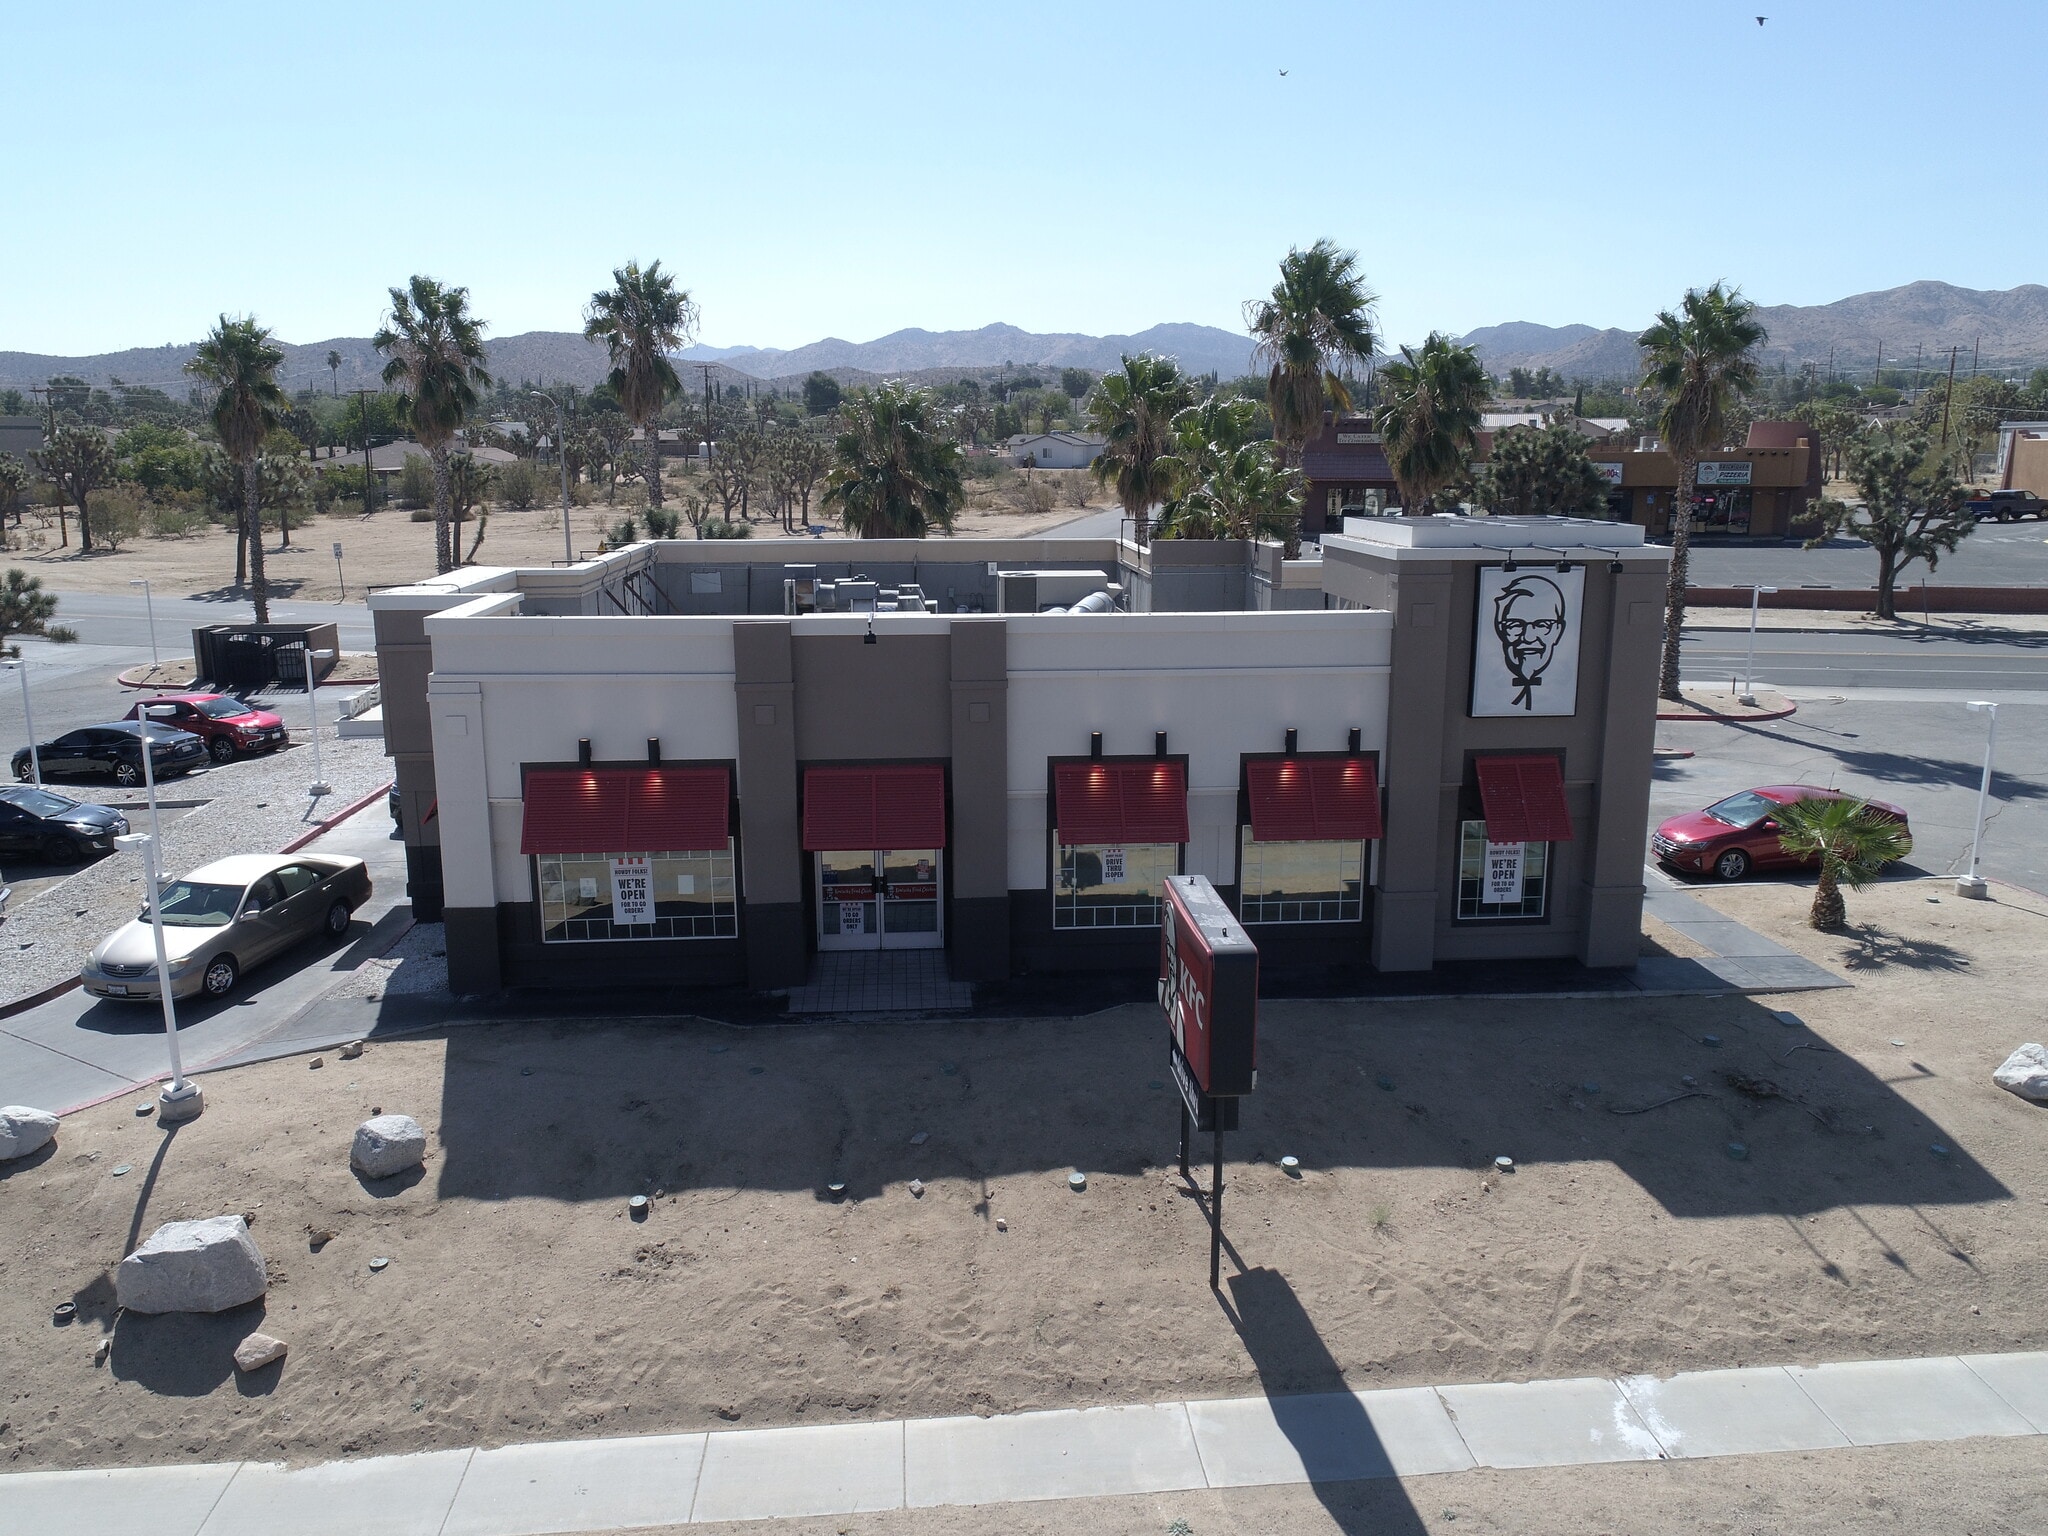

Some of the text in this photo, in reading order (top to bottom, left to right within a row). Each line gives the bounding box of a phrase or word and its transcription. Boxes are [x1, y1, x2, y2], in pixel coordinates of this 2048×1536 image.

[1491, 859, 1517, 869] WE'RE
[1492, 870, 1515, 880] OPEN
[618, 878, 646, 889] WE'RE
[620, 889, 645, 900] OPEN
[1180, 957, 1205, 1031] KFC
